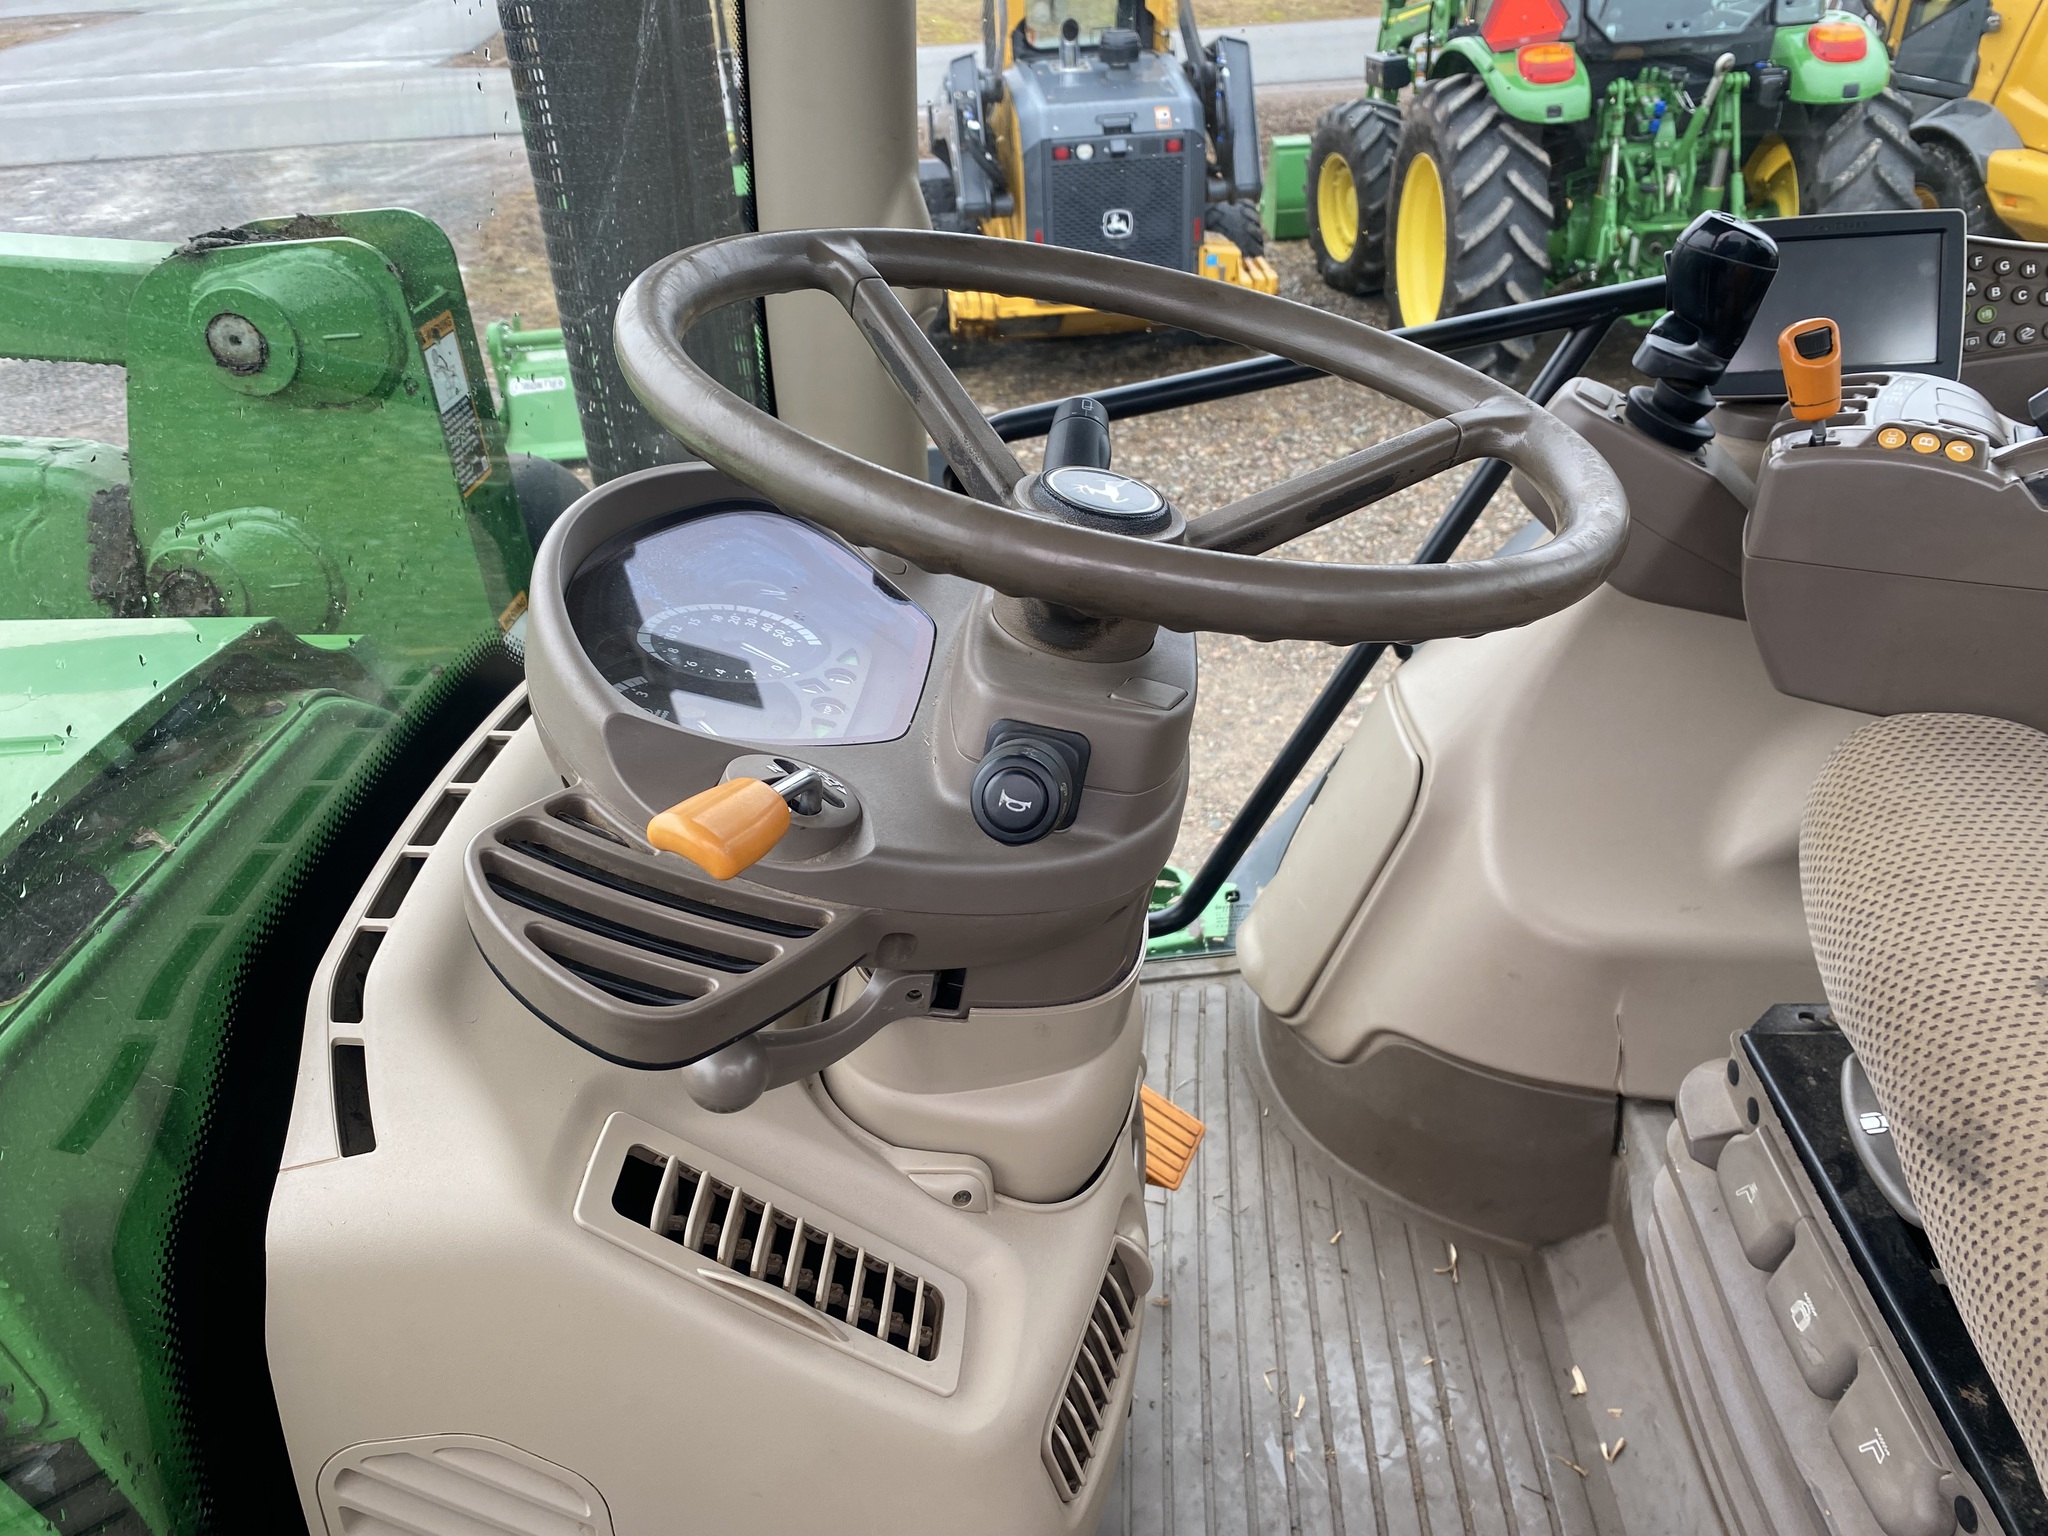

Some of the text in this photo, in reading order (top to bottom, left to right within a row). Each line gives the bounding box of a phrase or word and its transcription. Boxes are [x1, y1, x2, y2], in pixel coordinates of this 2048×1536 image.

[1975, 256, 2036, 274] F G H
[1967, 282, 2028, 300] A B C
[1886, 432, 1899, 444] BC
[1919, 437, 1935, 447] B
[1952, 445, 1968, 456] A
[688, 618, 701, 626] 15
[711, 614, 724, 623] 18
[728, 615, 741, 625] 20
[745, 617, 758, 628] 30
[669, 625, 683, 633] 12
[761, 622, 774, 633] 40
[772, 629, 786, 640] 50
[782, 637, 796, 647] 60
[636, 690, 648, 698] 3
